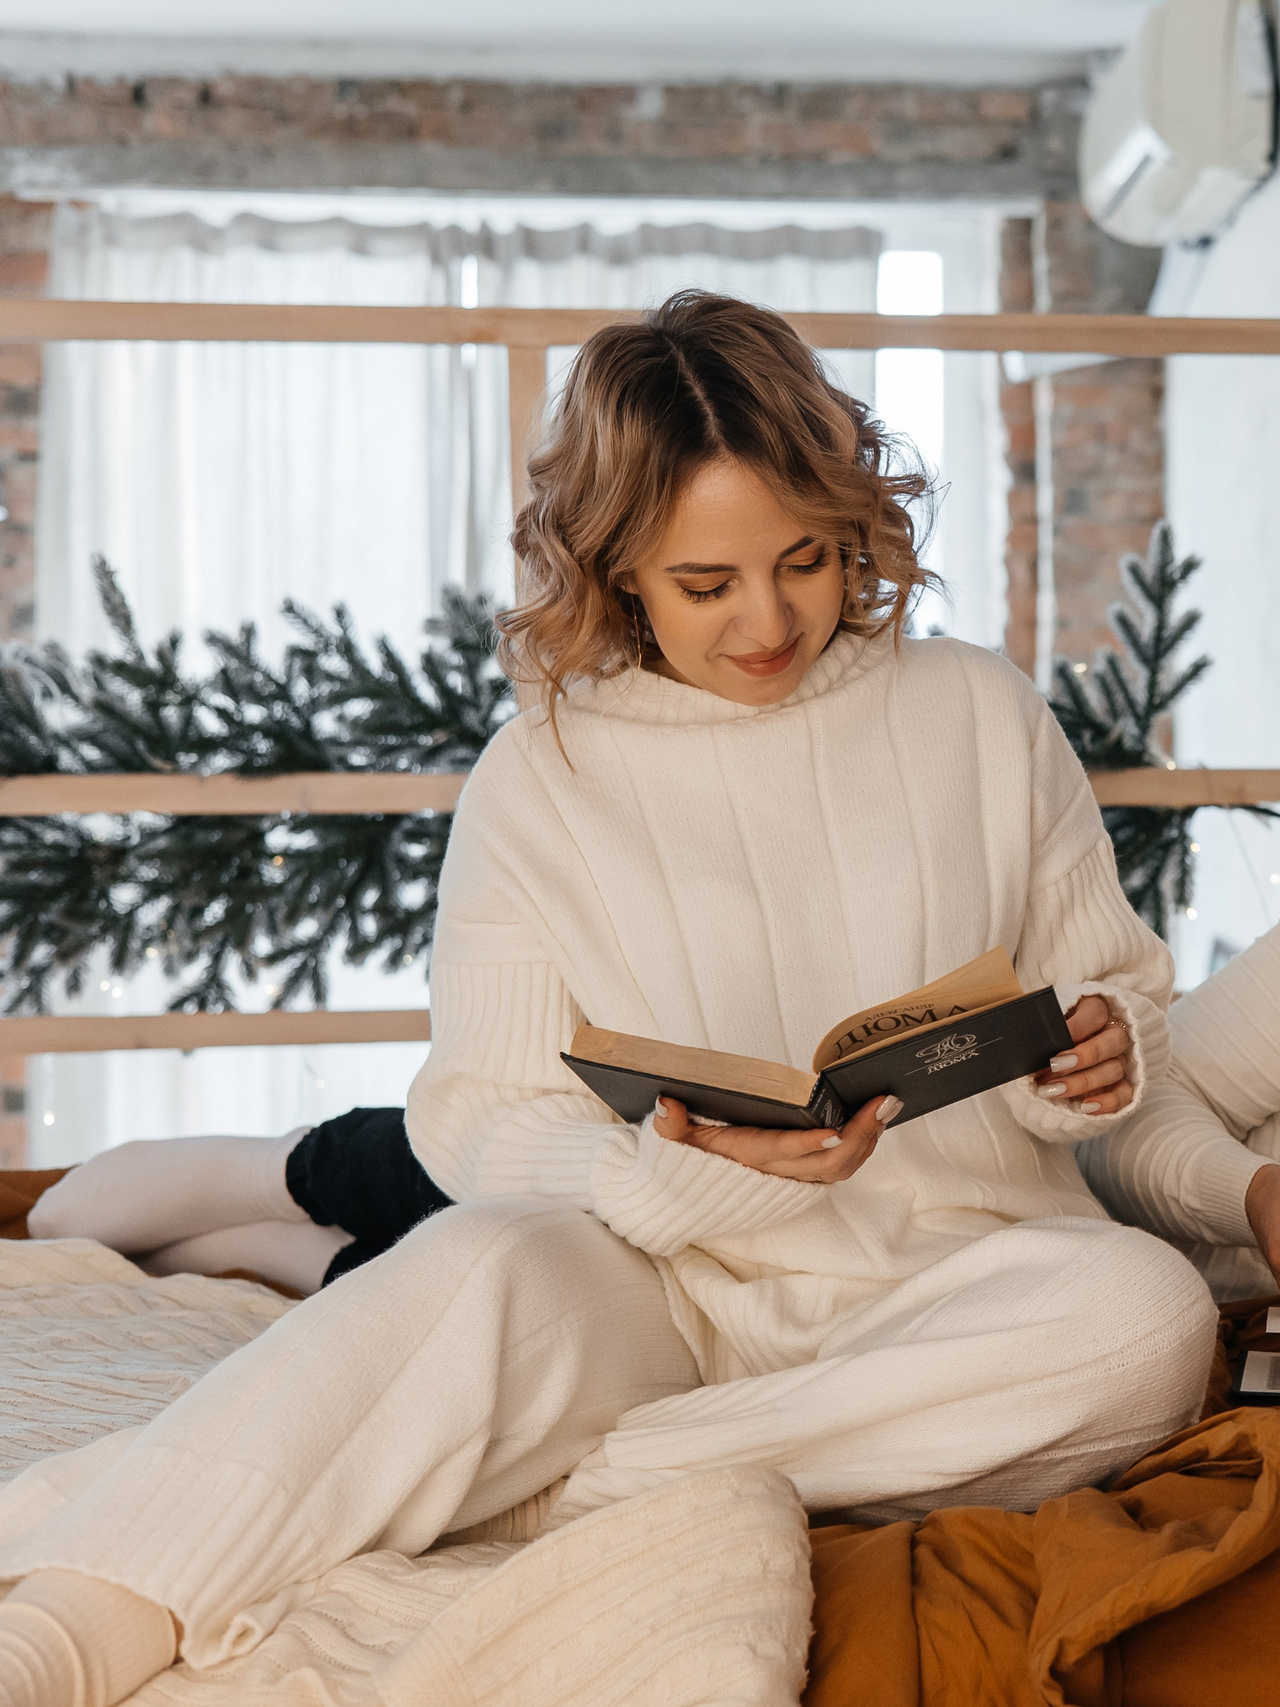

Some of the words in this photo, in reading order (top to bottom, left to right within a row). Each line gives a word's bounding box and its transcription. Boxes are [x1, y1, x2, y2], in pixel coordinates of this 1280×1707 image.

[864, 1003, 935, 1022] АЛЕКСАНДР
[833, 1004, 969, 1059] ДЮМА
[927, 1051, 980, 1075] ДЮМА
